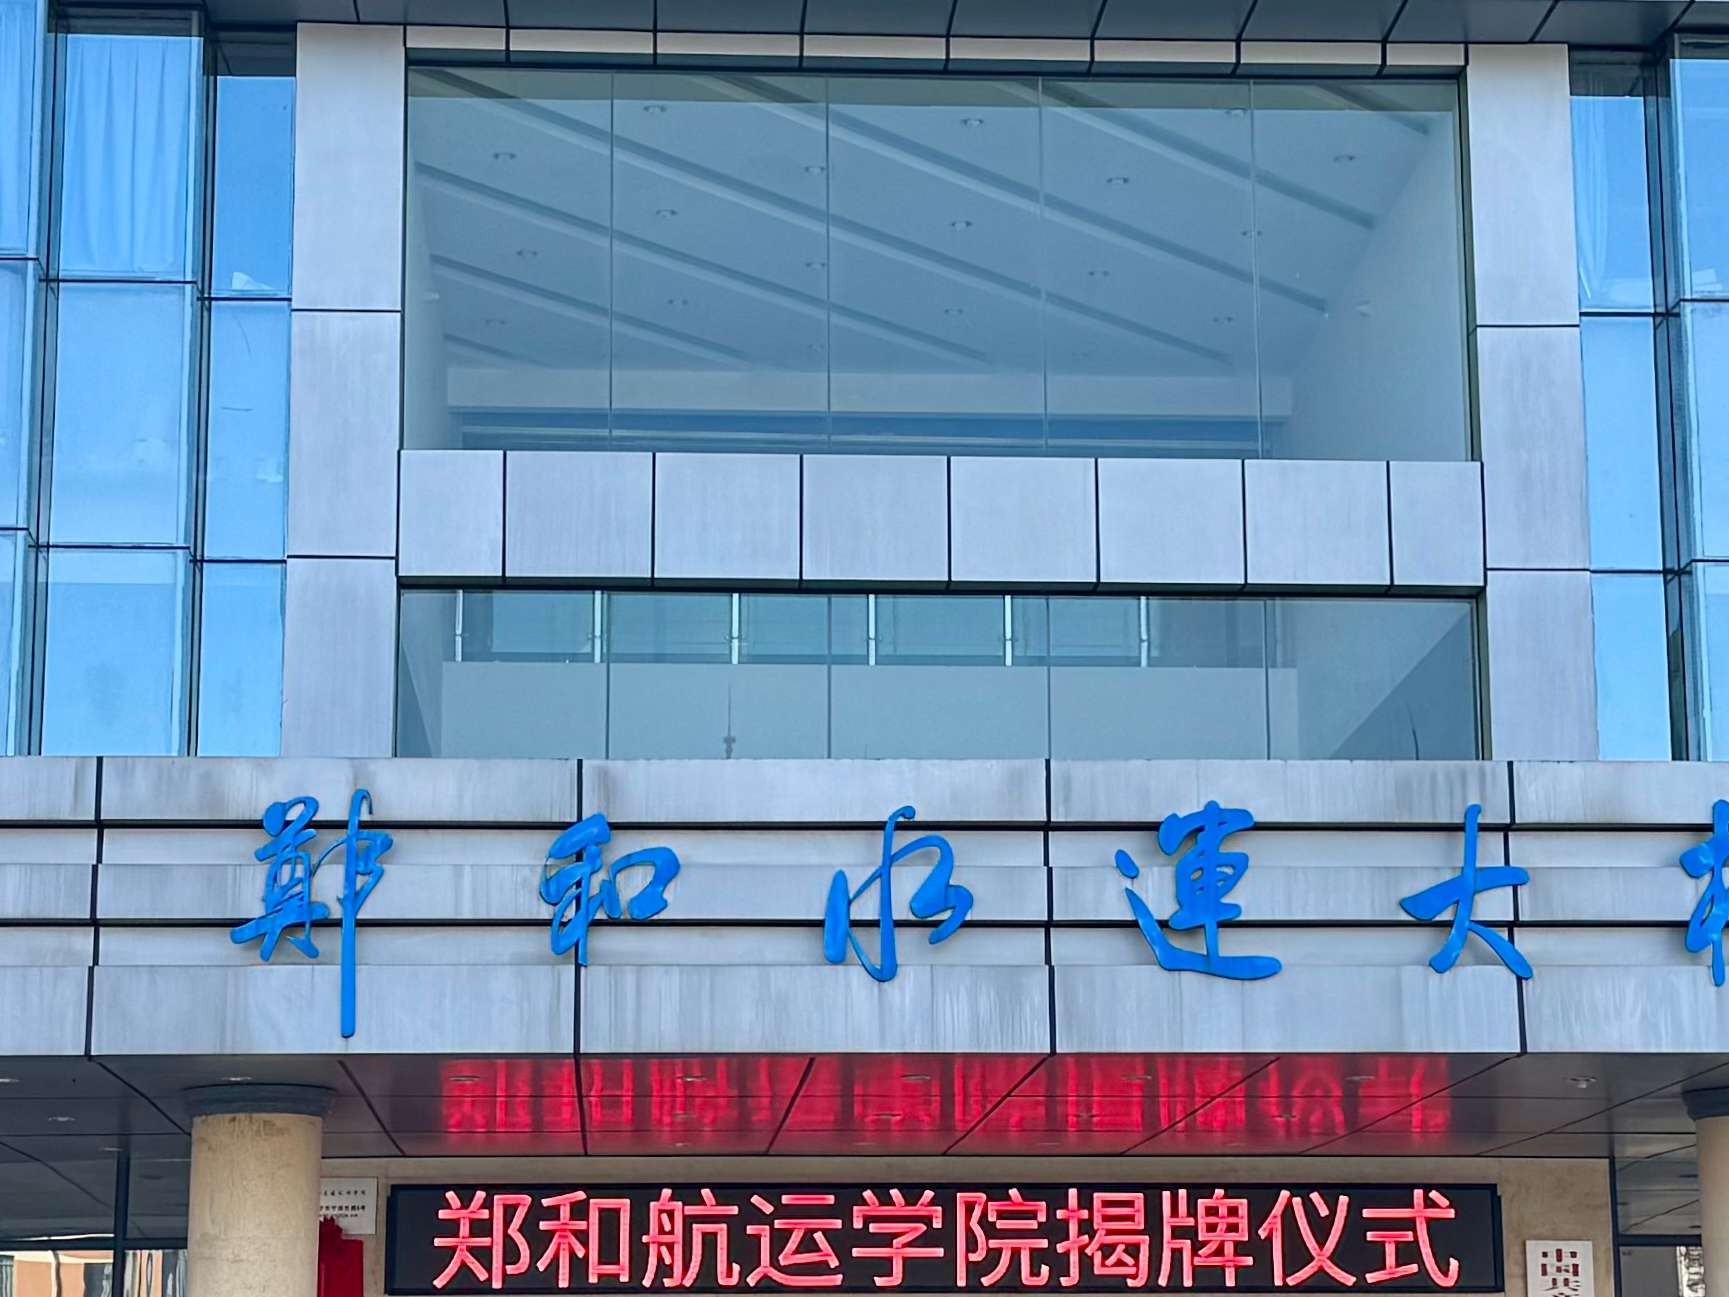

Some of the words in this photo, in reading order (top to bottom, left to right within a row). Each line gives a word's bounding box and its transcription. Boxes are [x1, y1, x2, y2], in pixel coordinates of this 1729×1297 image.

[431, 1187, 1461, 1290] 郑和航运学院揭牌仪式
